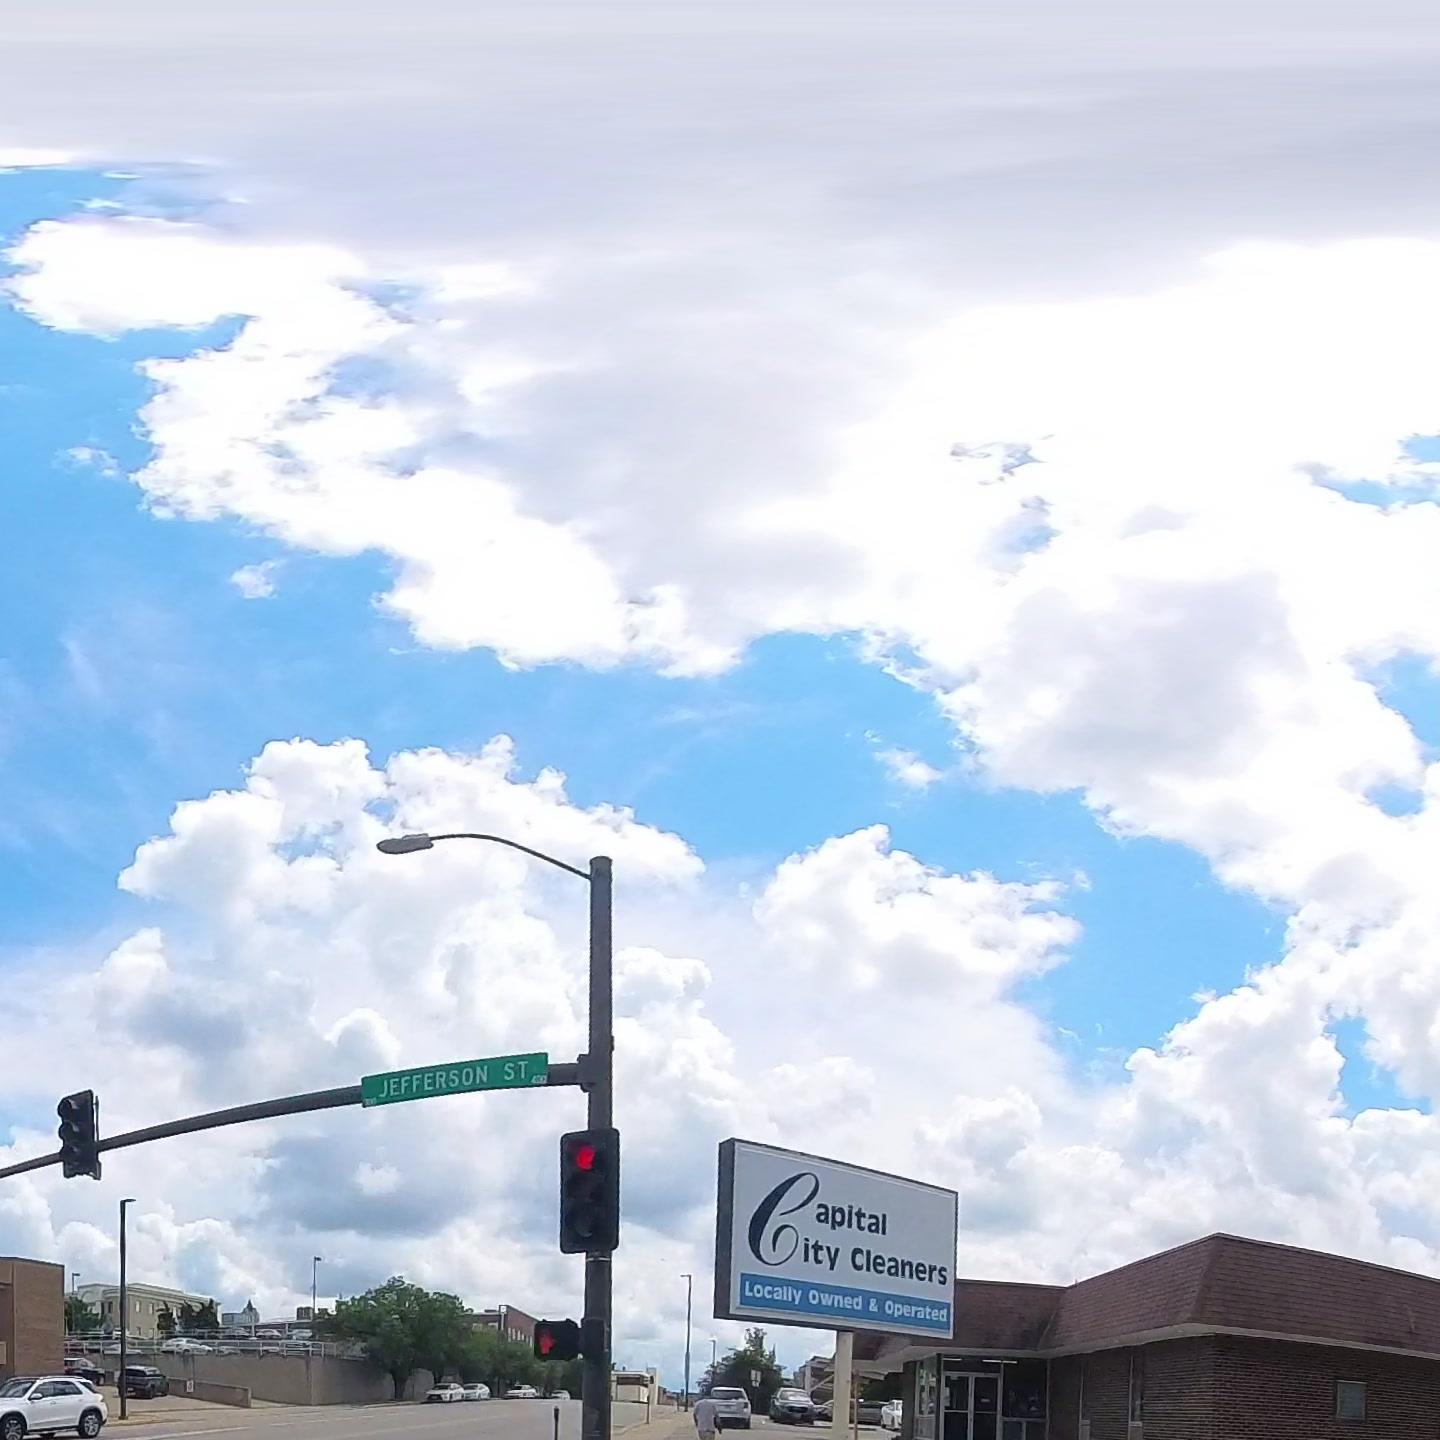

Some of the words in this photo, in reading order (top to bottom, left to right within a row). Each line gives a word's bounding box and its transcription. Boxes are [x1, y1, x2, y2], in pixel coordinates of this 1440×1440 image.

[378, 1065, 489, 1098] JEFFERSON
[504, 1061, 529, 1081] ST
[851, 1247, 948, 1286] Cleaners
[744, 1280, 802, 1305] Locally
[808, 1289, 863, 1311] Owned
[869, 1298, 879, 1312] &
[885, 1300, 948, 1322] Operated
